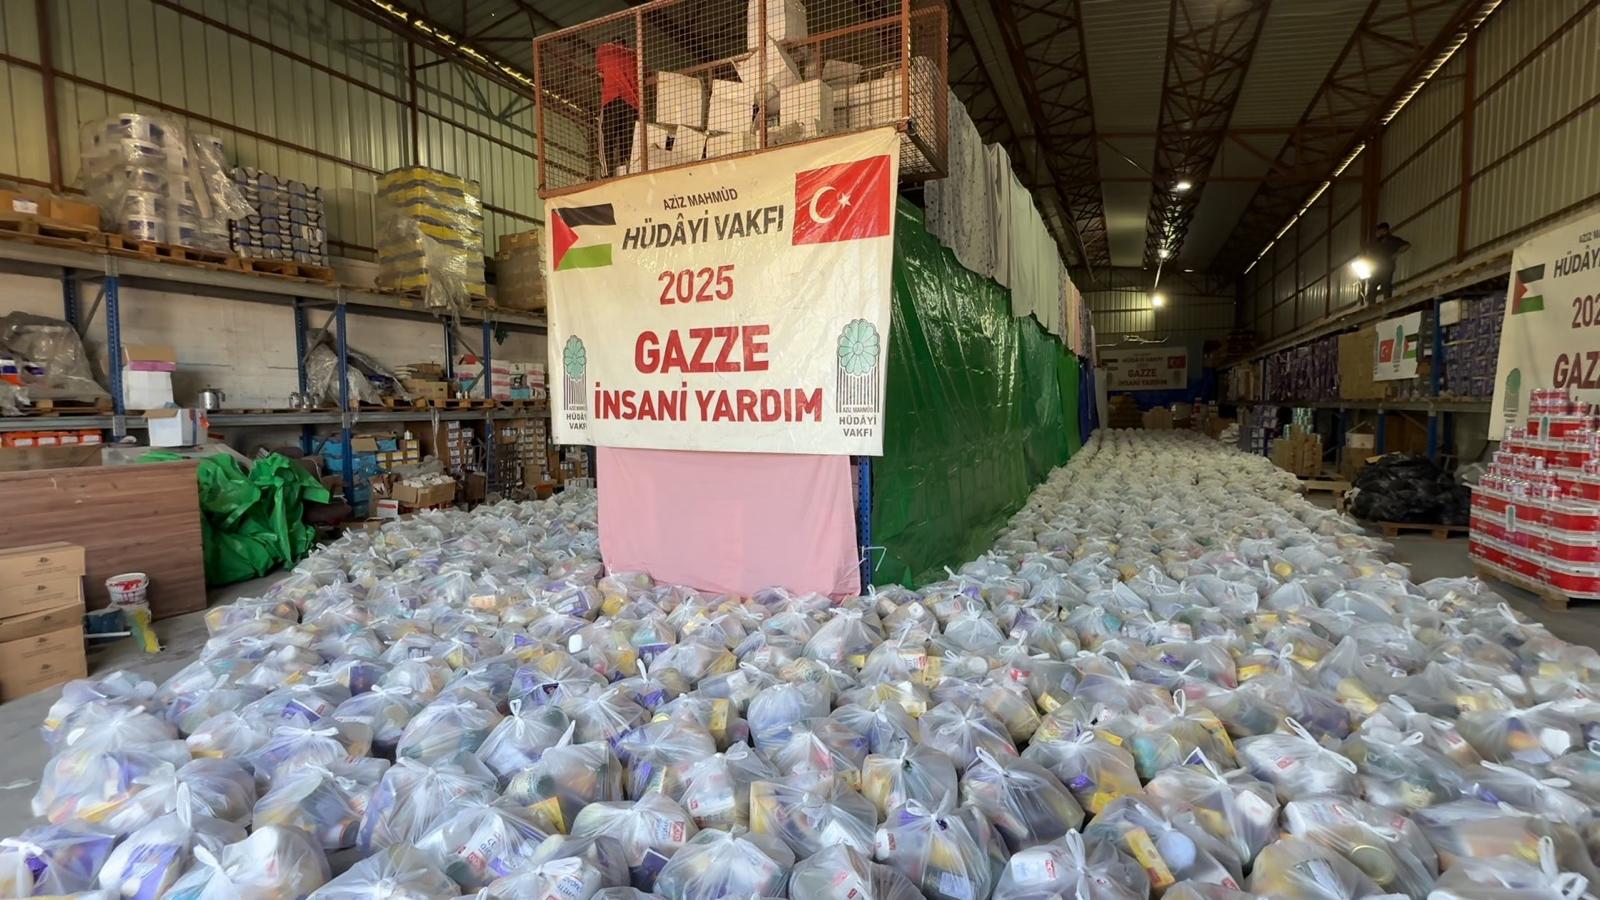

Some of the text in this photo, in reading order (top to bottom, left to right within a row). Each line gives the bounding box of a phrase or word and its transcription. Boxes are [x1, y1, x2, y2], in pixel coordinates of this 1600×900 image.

[663, 187, 738, 211] AZİZ MAHMÛD
[622, 205, 784, 251] HÜDÂYİ VAKFI
[1553, 244, 1600, 279] HÜDÂY
[659, 265, 735, 305] 2025
[634, 324, 771, 375] GAZZE
[1552, 351, 1600, 389] GAZ
[594, 381, 824, 423] İNSANİ YARDIM
[839, 414, 877, 425] HÜDÂYİ
[843, 428, 873, 437] VAKFI
